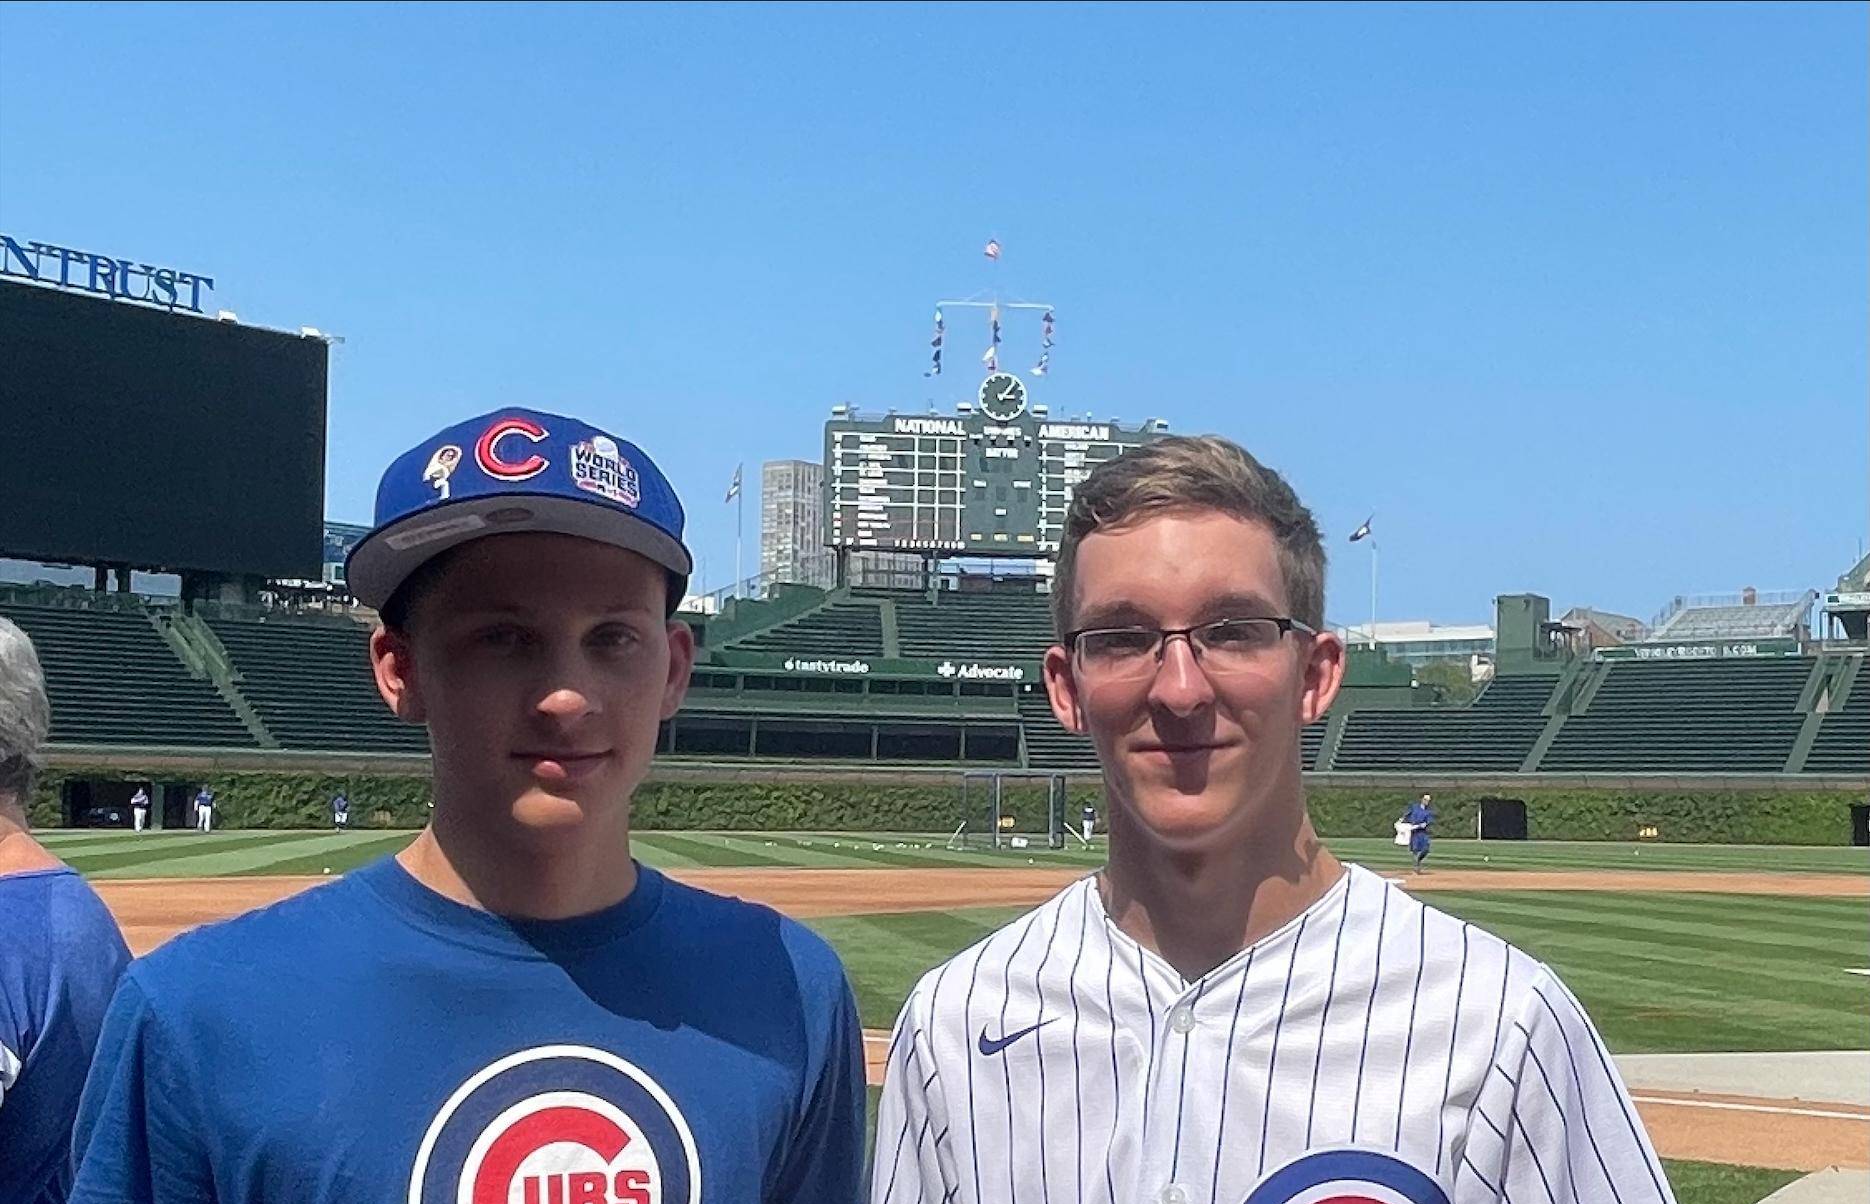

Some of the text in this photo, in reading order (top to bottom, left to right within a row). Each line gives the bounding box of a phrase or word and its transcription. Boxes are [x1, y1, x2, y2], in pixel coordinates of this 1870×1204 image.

[894, 418, 967, 436] NATIONAL
[1038, 424, 1110, 441] AMERICAN
[474, 417, 550, 482] C
[575, 447, 635, 483] WORLD
[575, 461, 638, 497] SERIES
[795, 658, 870, 675] tastytrade
[957, 664, 1024, 679] Advocate
